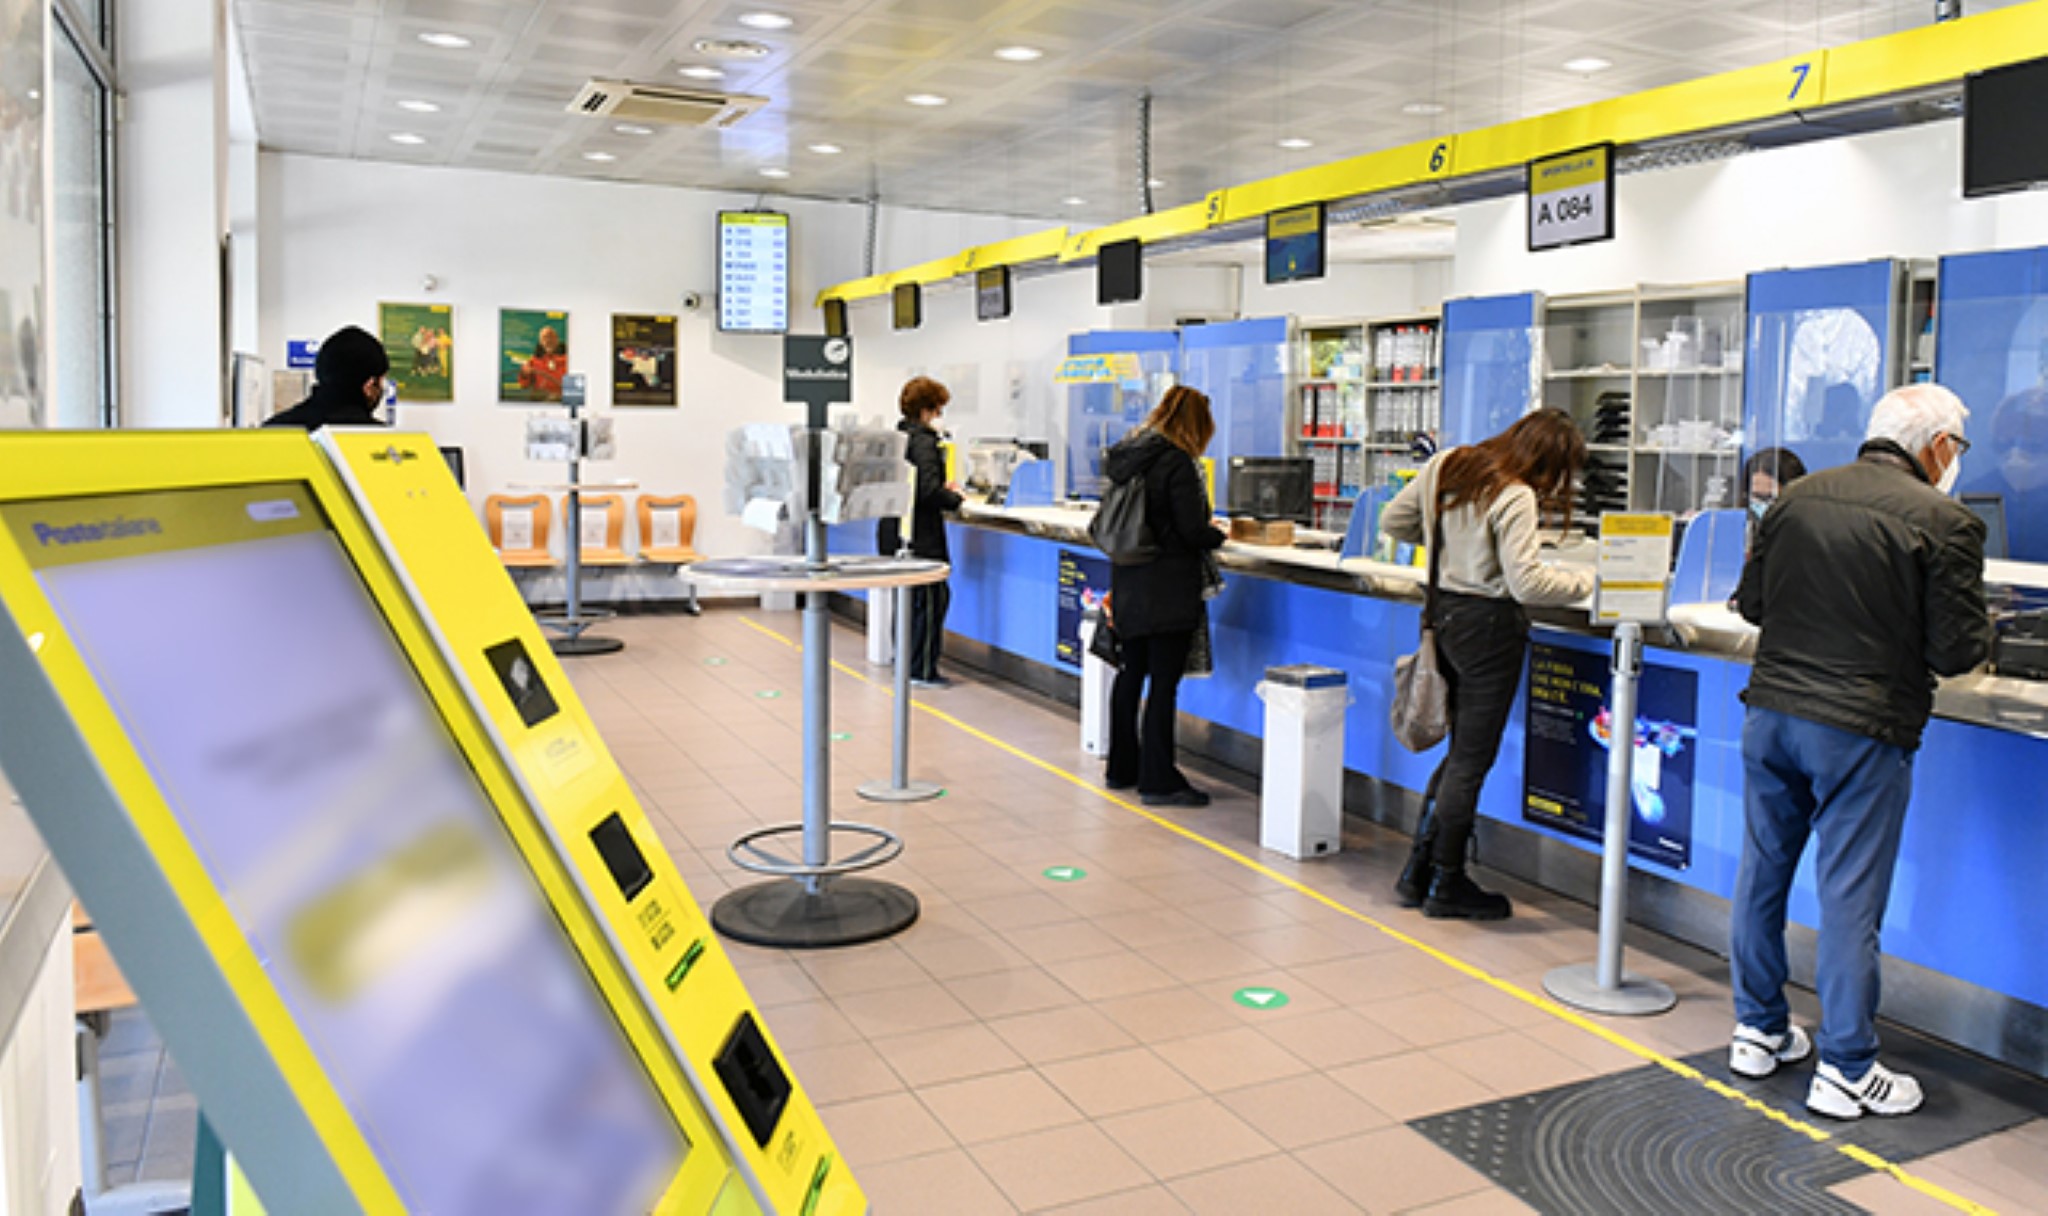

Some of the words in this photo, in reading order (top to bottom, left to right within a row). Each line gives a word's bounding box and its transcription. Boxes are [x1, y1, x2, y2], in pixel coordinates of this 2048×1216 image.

[1788, 63, 1811, 100] 7
[1430, 143, 1446, 172] 6
[1208, 196, 1219, 220] 5
[1537, 203, 1554, 225] A
[1557, 194, 1594, 222] 084
